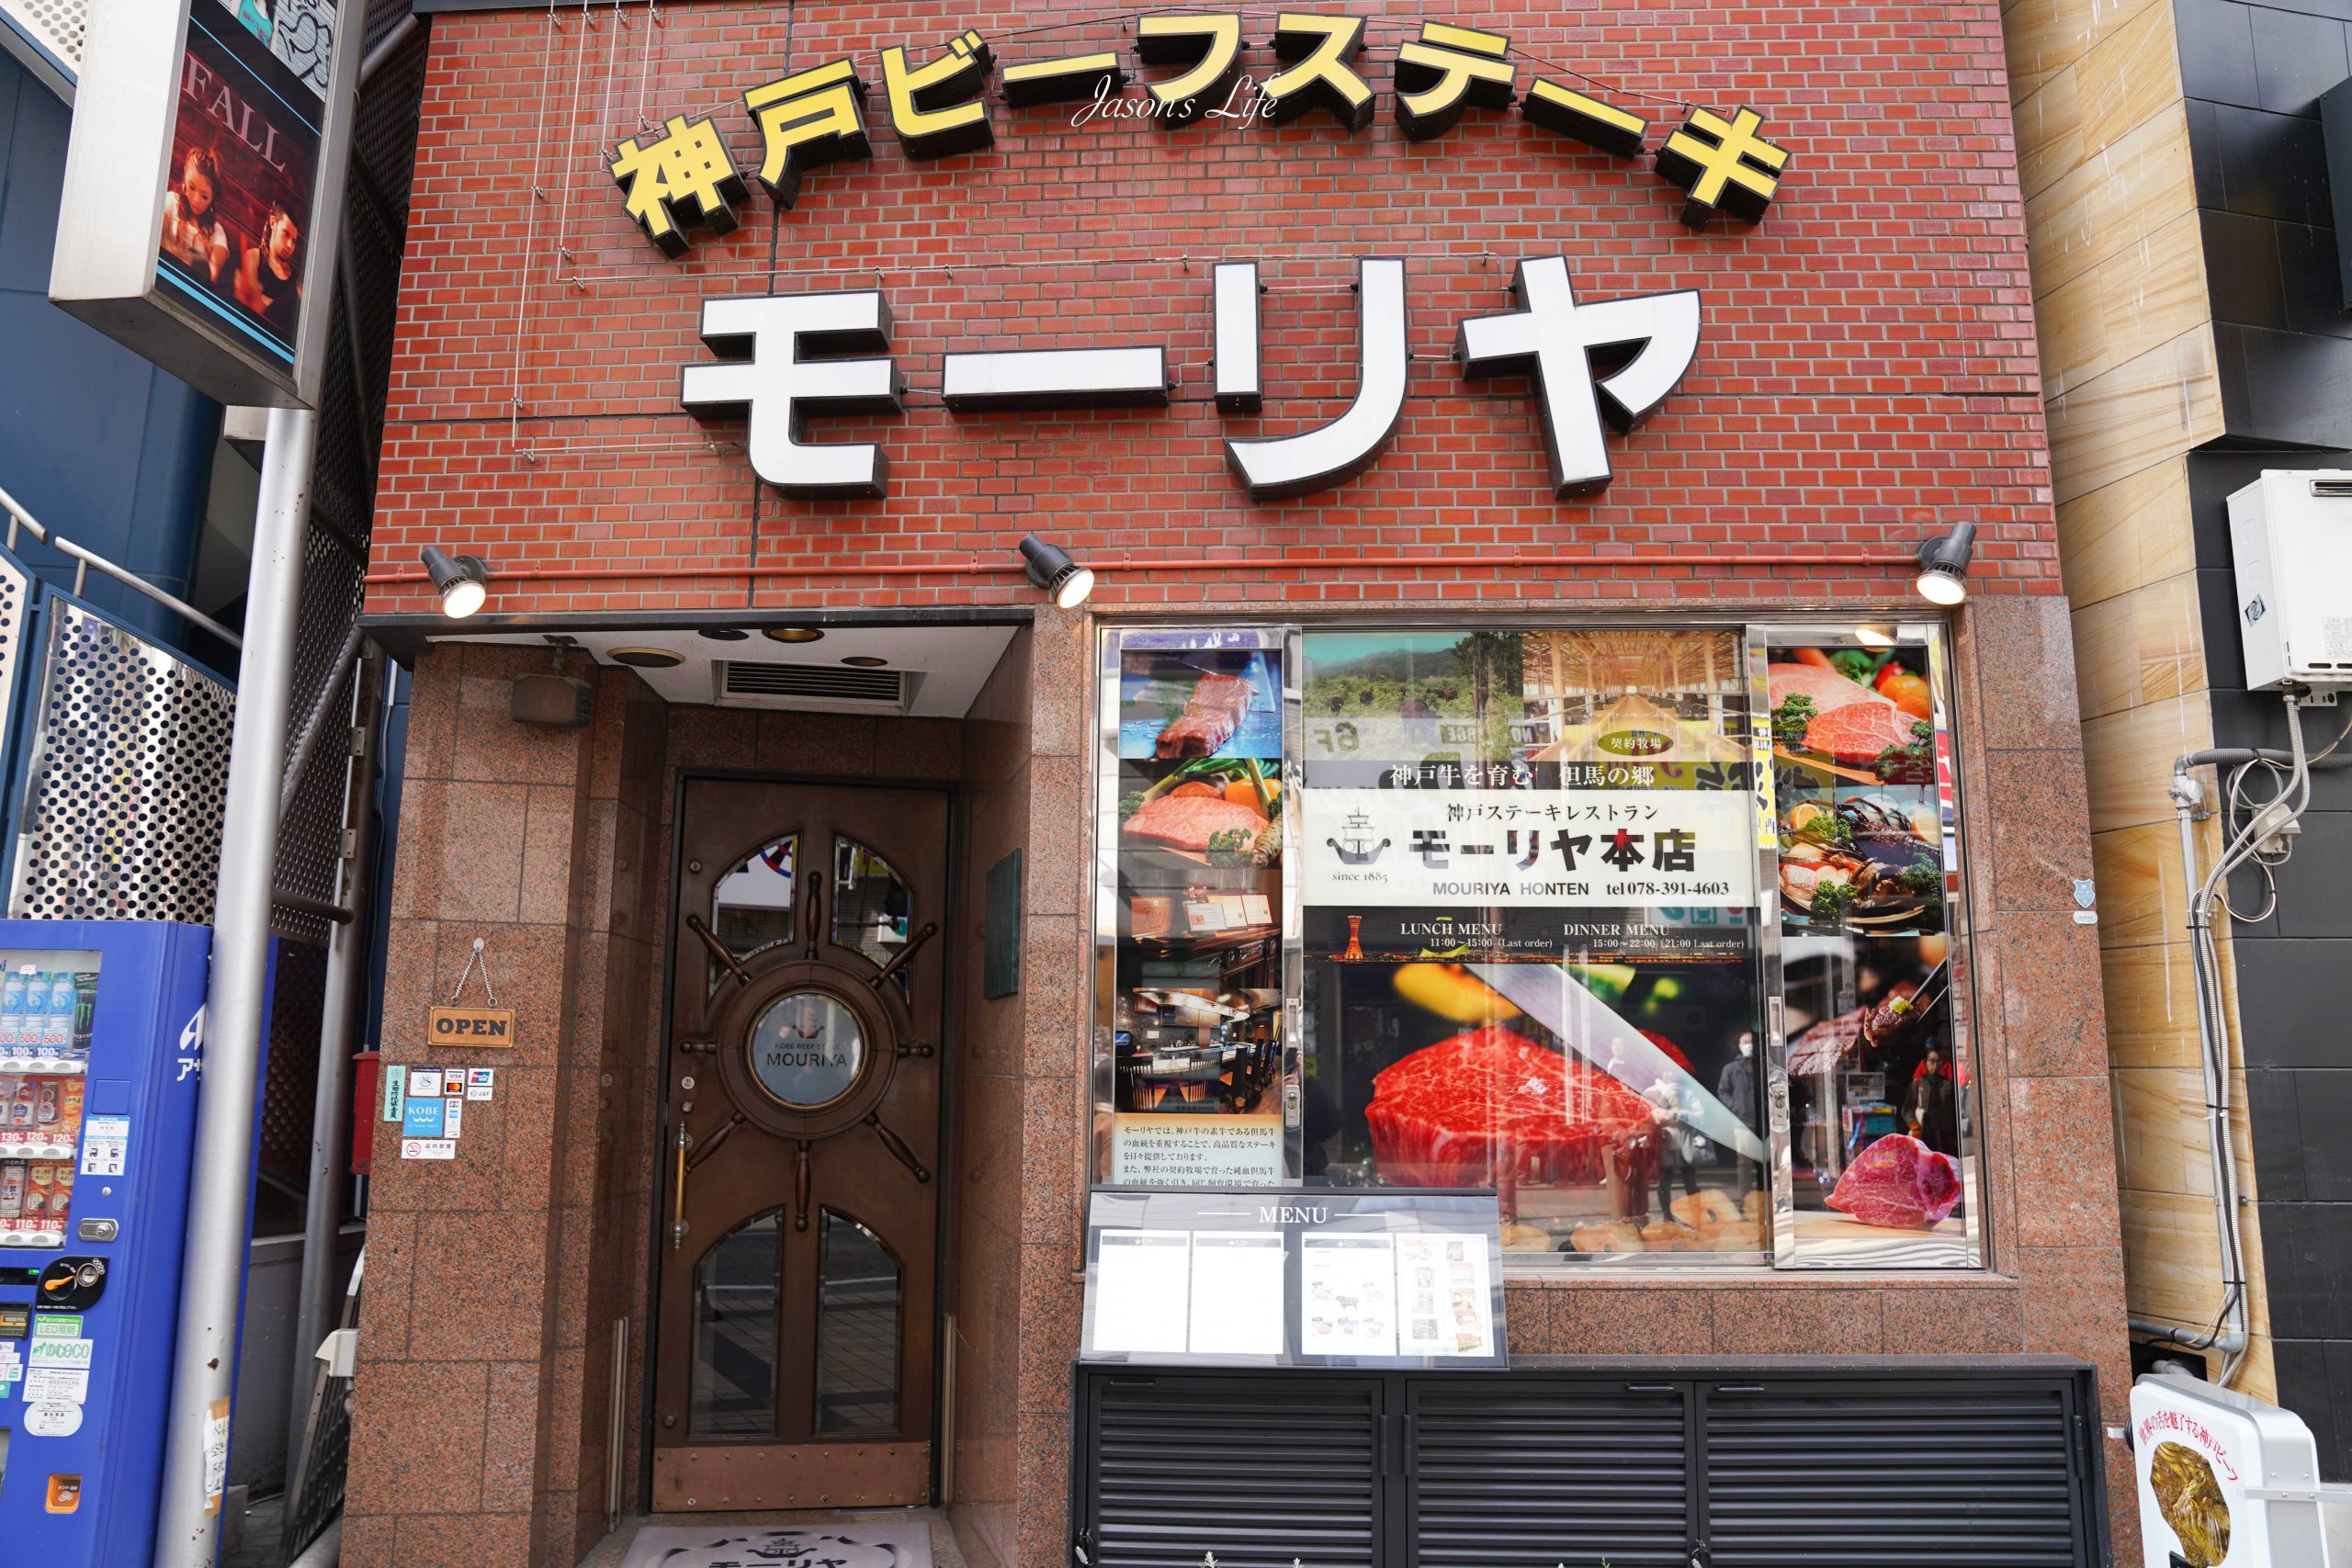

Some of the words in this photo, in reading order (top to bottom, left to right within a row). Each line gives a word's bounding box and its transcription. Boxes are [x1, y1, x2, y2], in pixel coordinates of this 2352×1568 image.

[183, 52, 287, 173] FALL
[610, 12, 1792, 243] 神戸ビーフステーキ
[681, 254, 1702, 494] モーリヤ
[1611, 737, 1662, 750] 契約牧場
[1389, 764, 1533, 786] 神戸牛を育む
[1559, 765, 1655, 786] 但馬の郷
[1447, 803, 1659, 823] 神戸ステーキレストラン
[1409, 828, 1696, 873] モーリヤ本店
[1332, 870, 1360, 881] since
[1364, 872, 1388, 884] 1885
[1432, 882, 1510, 896] MOURIYA
[1521, 882, 1589, 896] HONTEN
[1400, 922, 1453, 935] LUNCH
[1458, 922, 1502, 935] MENU
[1563, 923, 1622, 936] DINNER
[1625, 923, 1669, 936] MENU
[1498, 938, 1522, 948] (Last
[1525, 938, 1553, 948] order)
[1693, 939, 1713, 948] Last
[1717, 939, 1745, 949] order)
[435, 1017, 508, 1036] OPEN
[816, 1043, 841, 1051] STK
[766, 1053, 847, 1066] MOURIYA
[408, 1106, 440, 1115] KOBE
[1257, 1206, 1329, 1224] MENU
